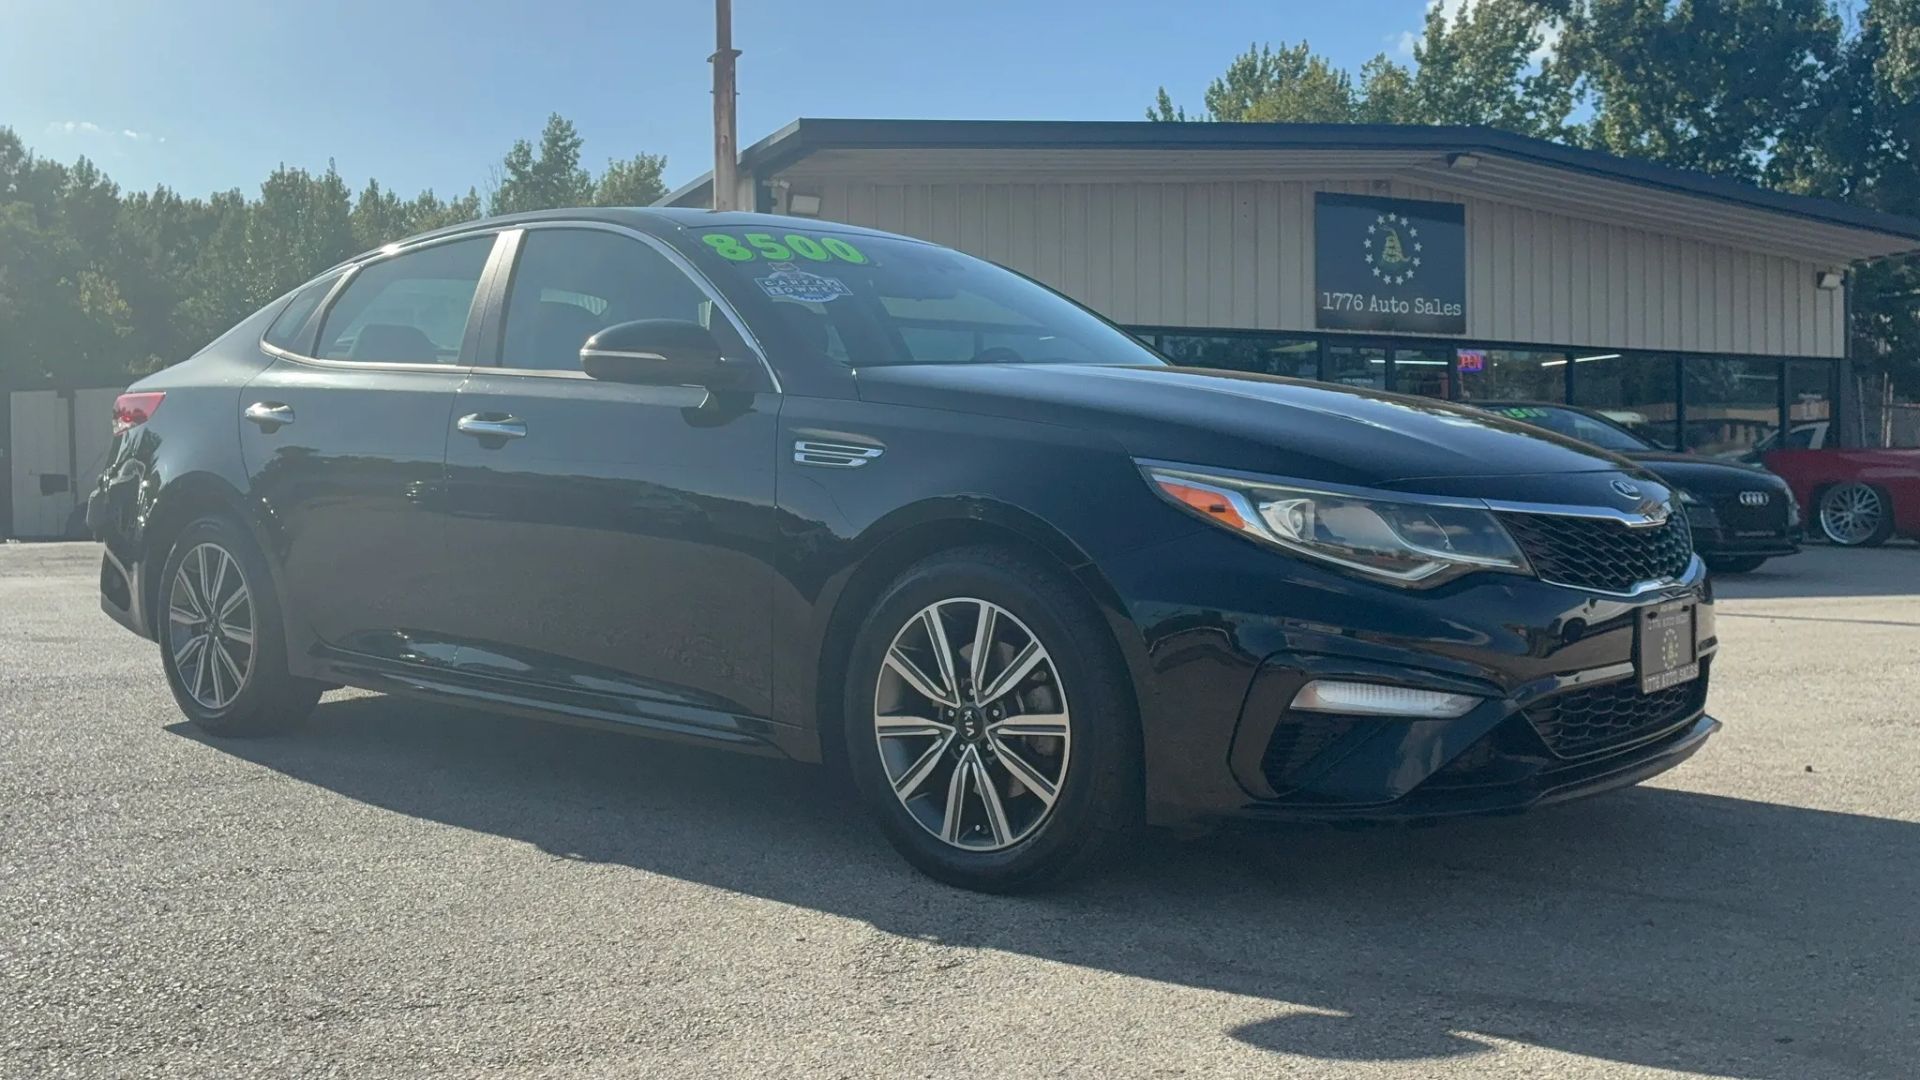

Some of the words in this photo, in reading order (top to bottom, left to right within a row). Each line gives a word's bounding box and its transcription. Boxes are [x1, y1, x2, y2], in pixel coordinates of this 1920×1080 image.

[702, 233, 869, 264] 8500
[1323, 292, 1363, 311] 1776
[1369, 294, 1409, 314] Auto
[1414, 297, 1462, 317] Sales
[964, 710, 975, 737] KIA
